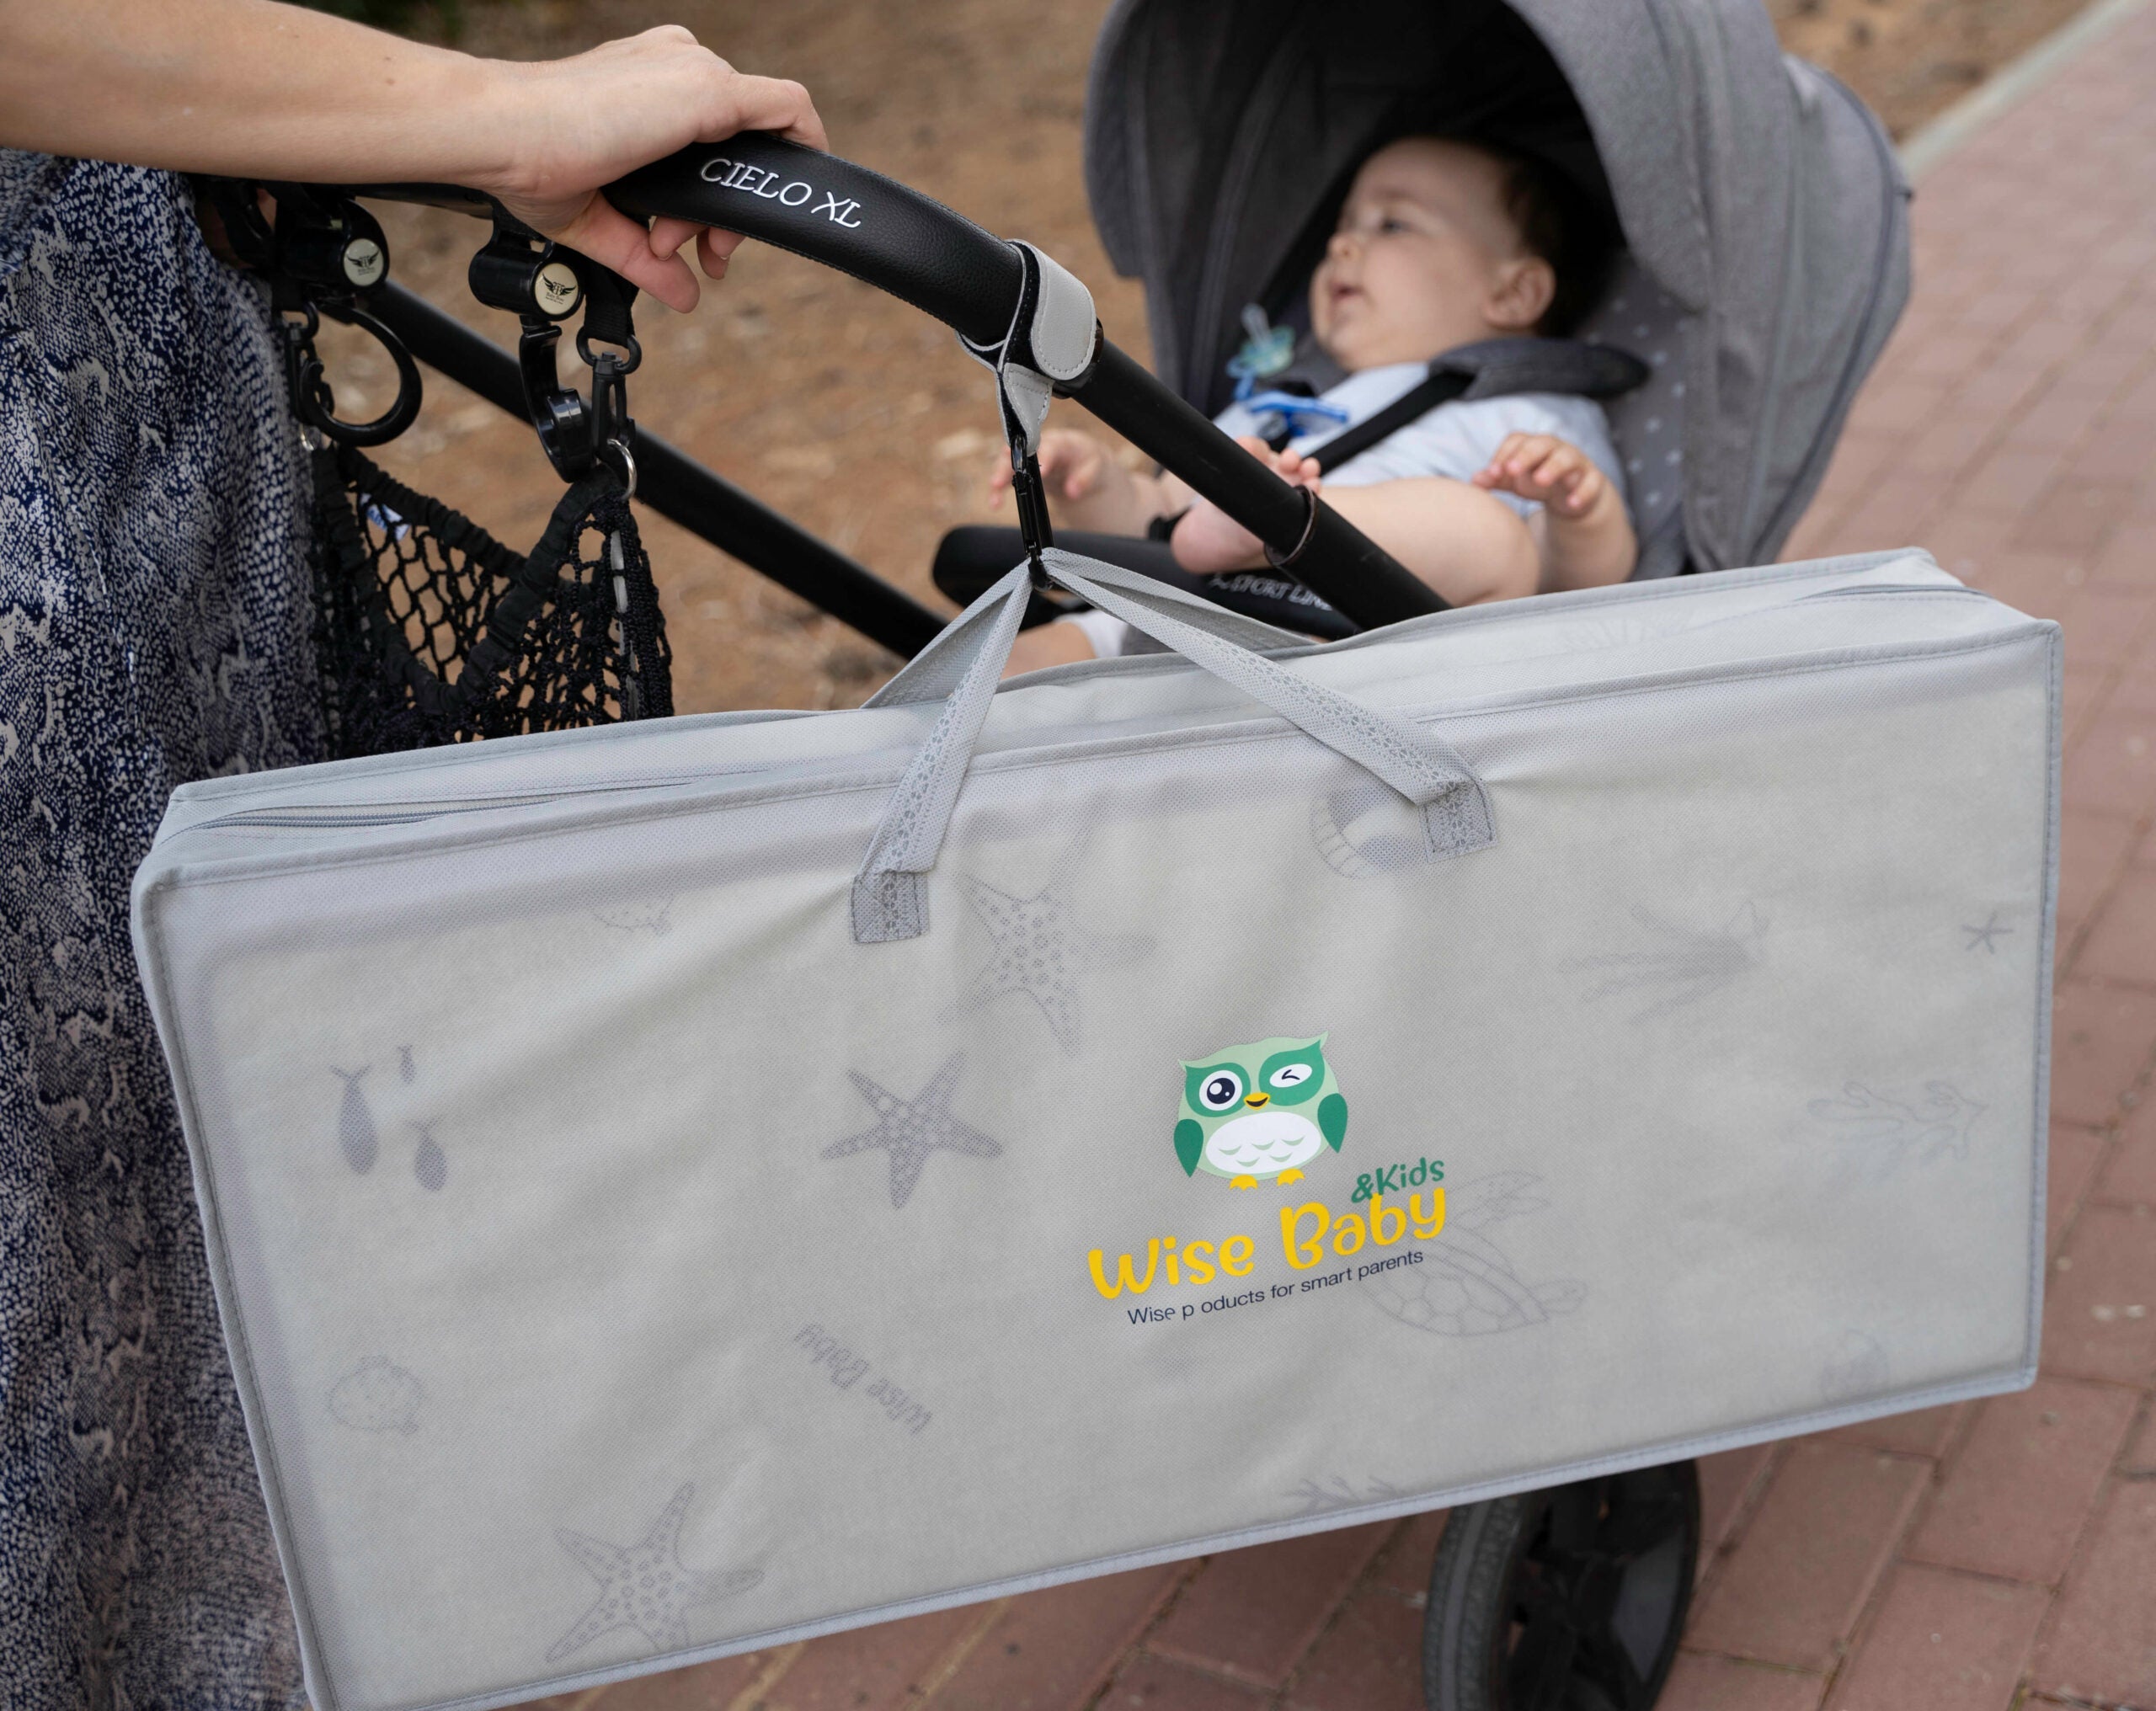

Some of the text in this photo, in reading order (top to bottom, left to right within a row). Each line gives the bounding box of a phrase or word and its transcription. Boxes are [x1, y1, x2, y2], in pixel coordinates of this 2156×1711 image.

[700, 158, 861, 228] CIELO XL
[1351, 1157, 1445, 1203] &Kids
[1087, 1186, 1447, 1300] Wise Baby
[1127, 1307, 1177, 1325] Wise
[1270, 1283, 1295, 1299] for
[1300, 1267, 1353, 1293] smart
[1358, 1250, 1424, 1282] parents
